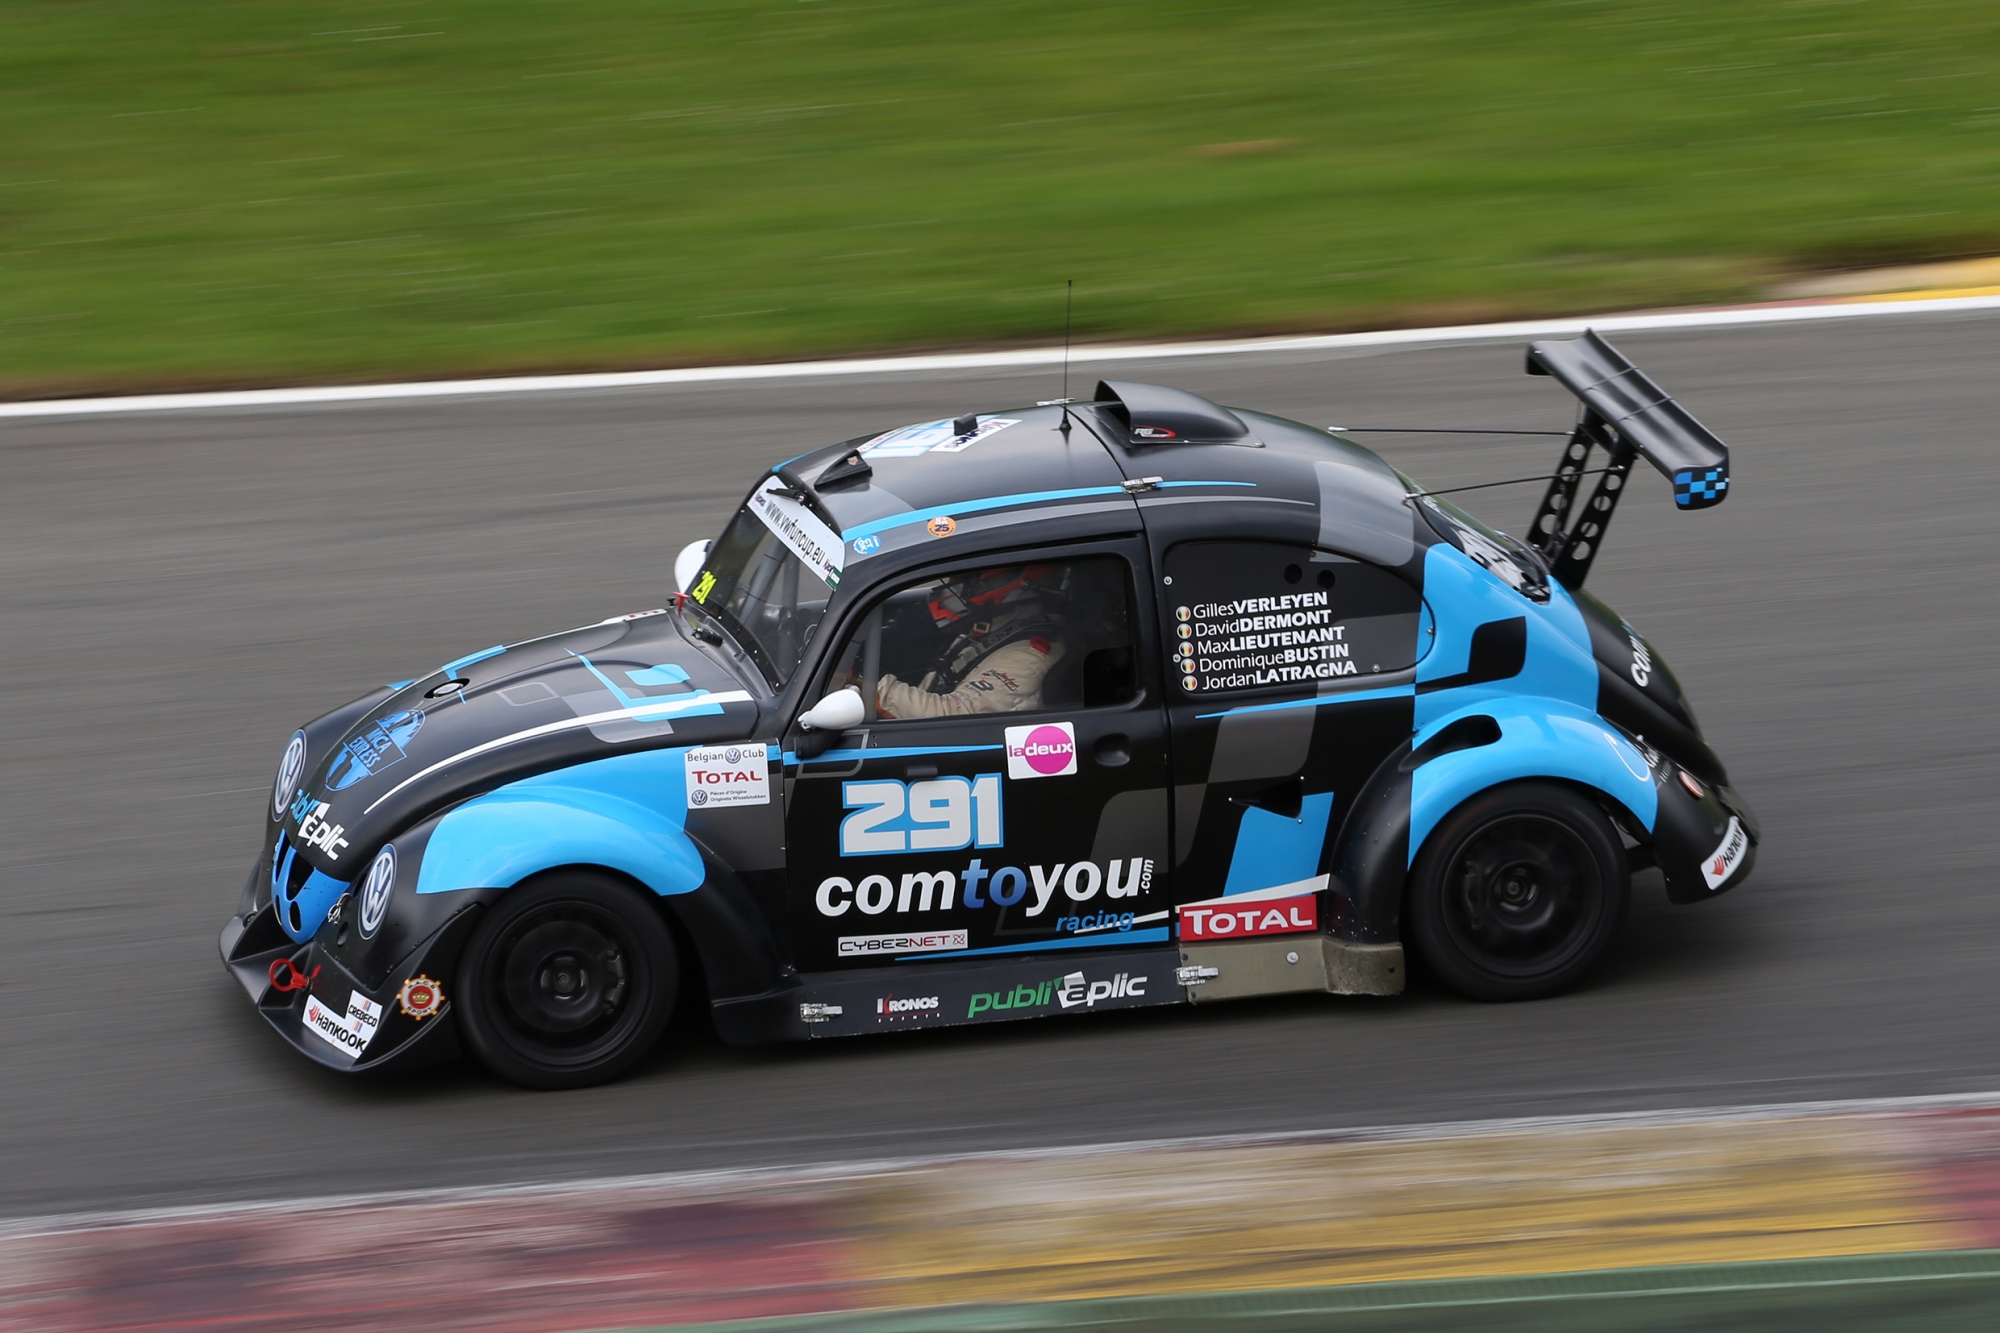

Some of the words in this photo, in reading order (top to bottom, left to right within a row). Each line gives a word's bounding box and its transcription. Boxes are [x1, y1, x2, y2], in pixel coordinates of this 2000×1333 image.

[764, 499, 826, 566] www.vwfuncup.eu
[687, 752, 724, 763] Belgian
[742, 749, 764, 759] Club
[692, 770, 763, 785] TOTAL
[839, 772, 1004, 858] 291
[1055, 909, 1135, 933] racing
[1183, 907, 1313, 935] TOTAL
[877, 993, 939, 1014] KRONOS
[348, 1004, 378, 1028] CREDECO
